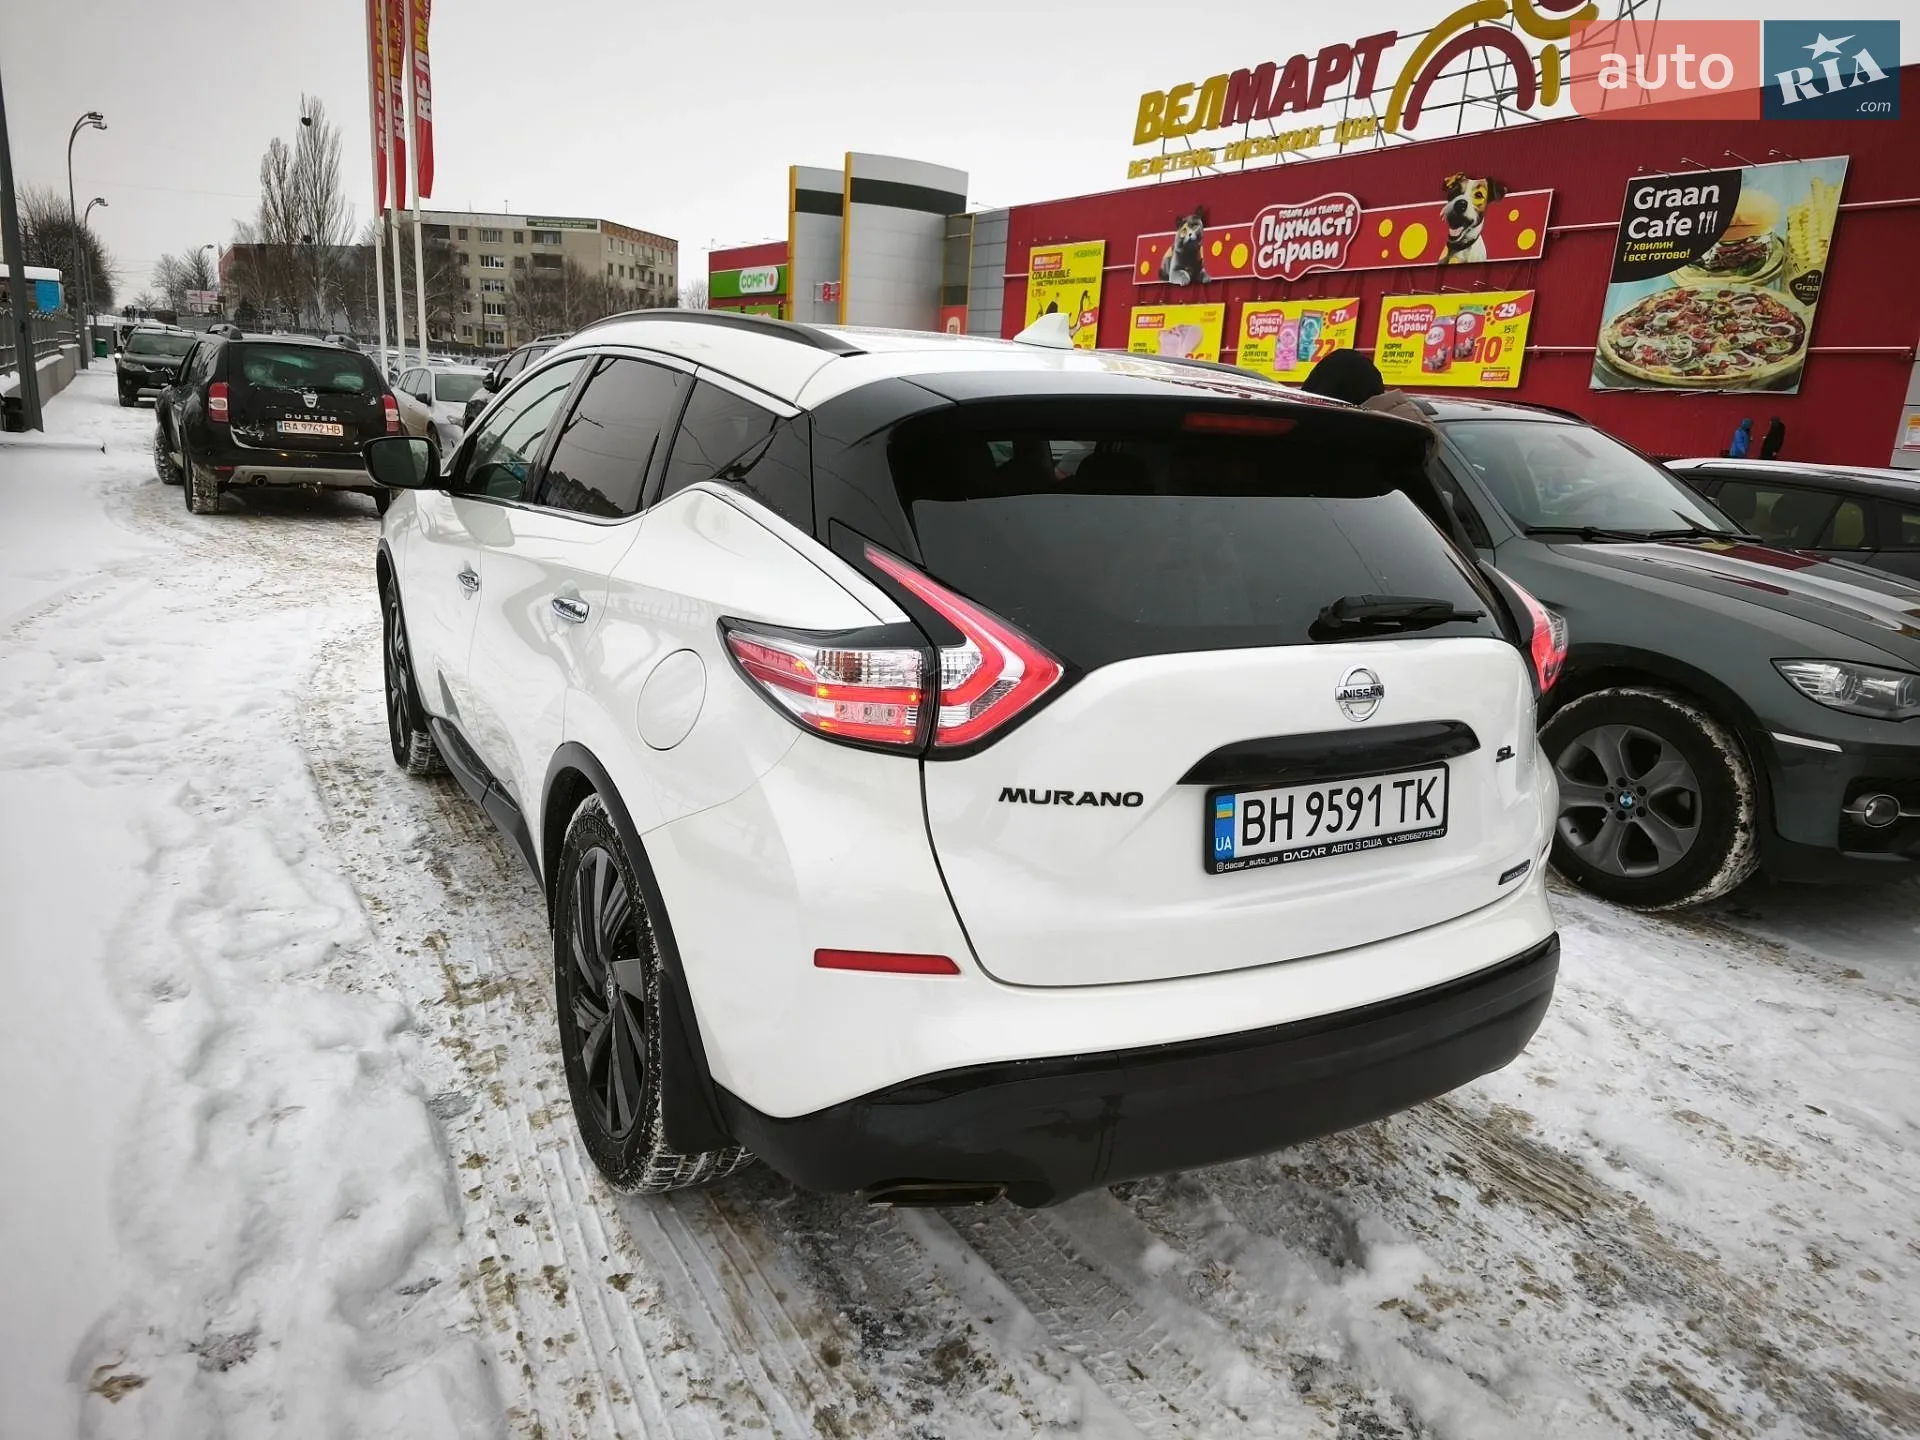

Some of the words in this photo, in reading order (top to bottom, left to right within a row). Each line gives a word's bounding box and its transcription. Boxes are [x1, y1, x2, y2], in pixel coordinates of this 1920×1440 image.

[1133, 30, 1398, 145] ВЕЛМАРТ
[1633, 185, 1720, 210] Graan
[1259, 215, 1353, 248] Пухнасті
[1627, 211, 1693, 239] Cafe
[1258, 240, 1339, 273] Справи
[1625, 241, 1632, 251] 7
[741, 272, 769, 288] COMFY
[1474, 336, 1503, 364] 10
[285, 413, 337, 422] DUSTER
[1343, 685, 1382, 699] NISSAN
[998, 787, 1144, 807] MURANO
[1242, 795, 1294, 846] BH
[1306, 783, 1382, 837] 9591
[1393, 776, 1438, 824] TK
[1215, 835, 1232, 851] UA
